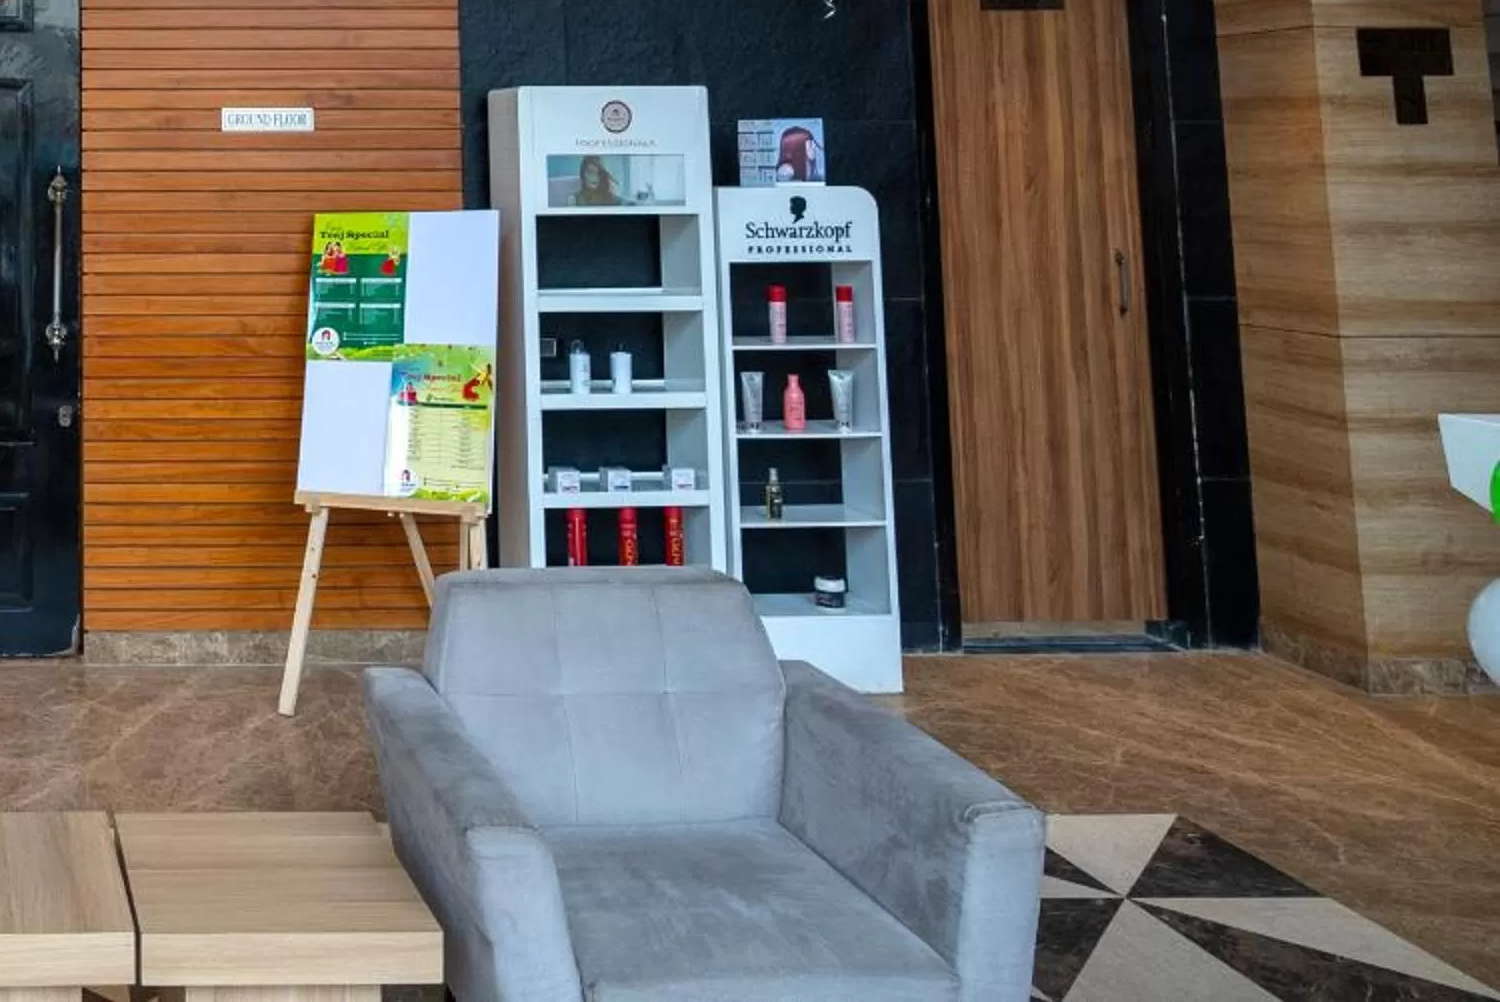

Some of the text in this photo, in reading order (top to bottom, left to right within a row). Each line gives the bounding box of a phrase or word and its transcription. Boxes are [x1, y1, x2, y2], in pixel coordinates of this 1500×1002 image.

[227, 113, 307, 126] GROUND FLOOR
[745, 221, 853, 242] Schwarzkopf
[748, 245, 852, 254] PROFESSIONAL
